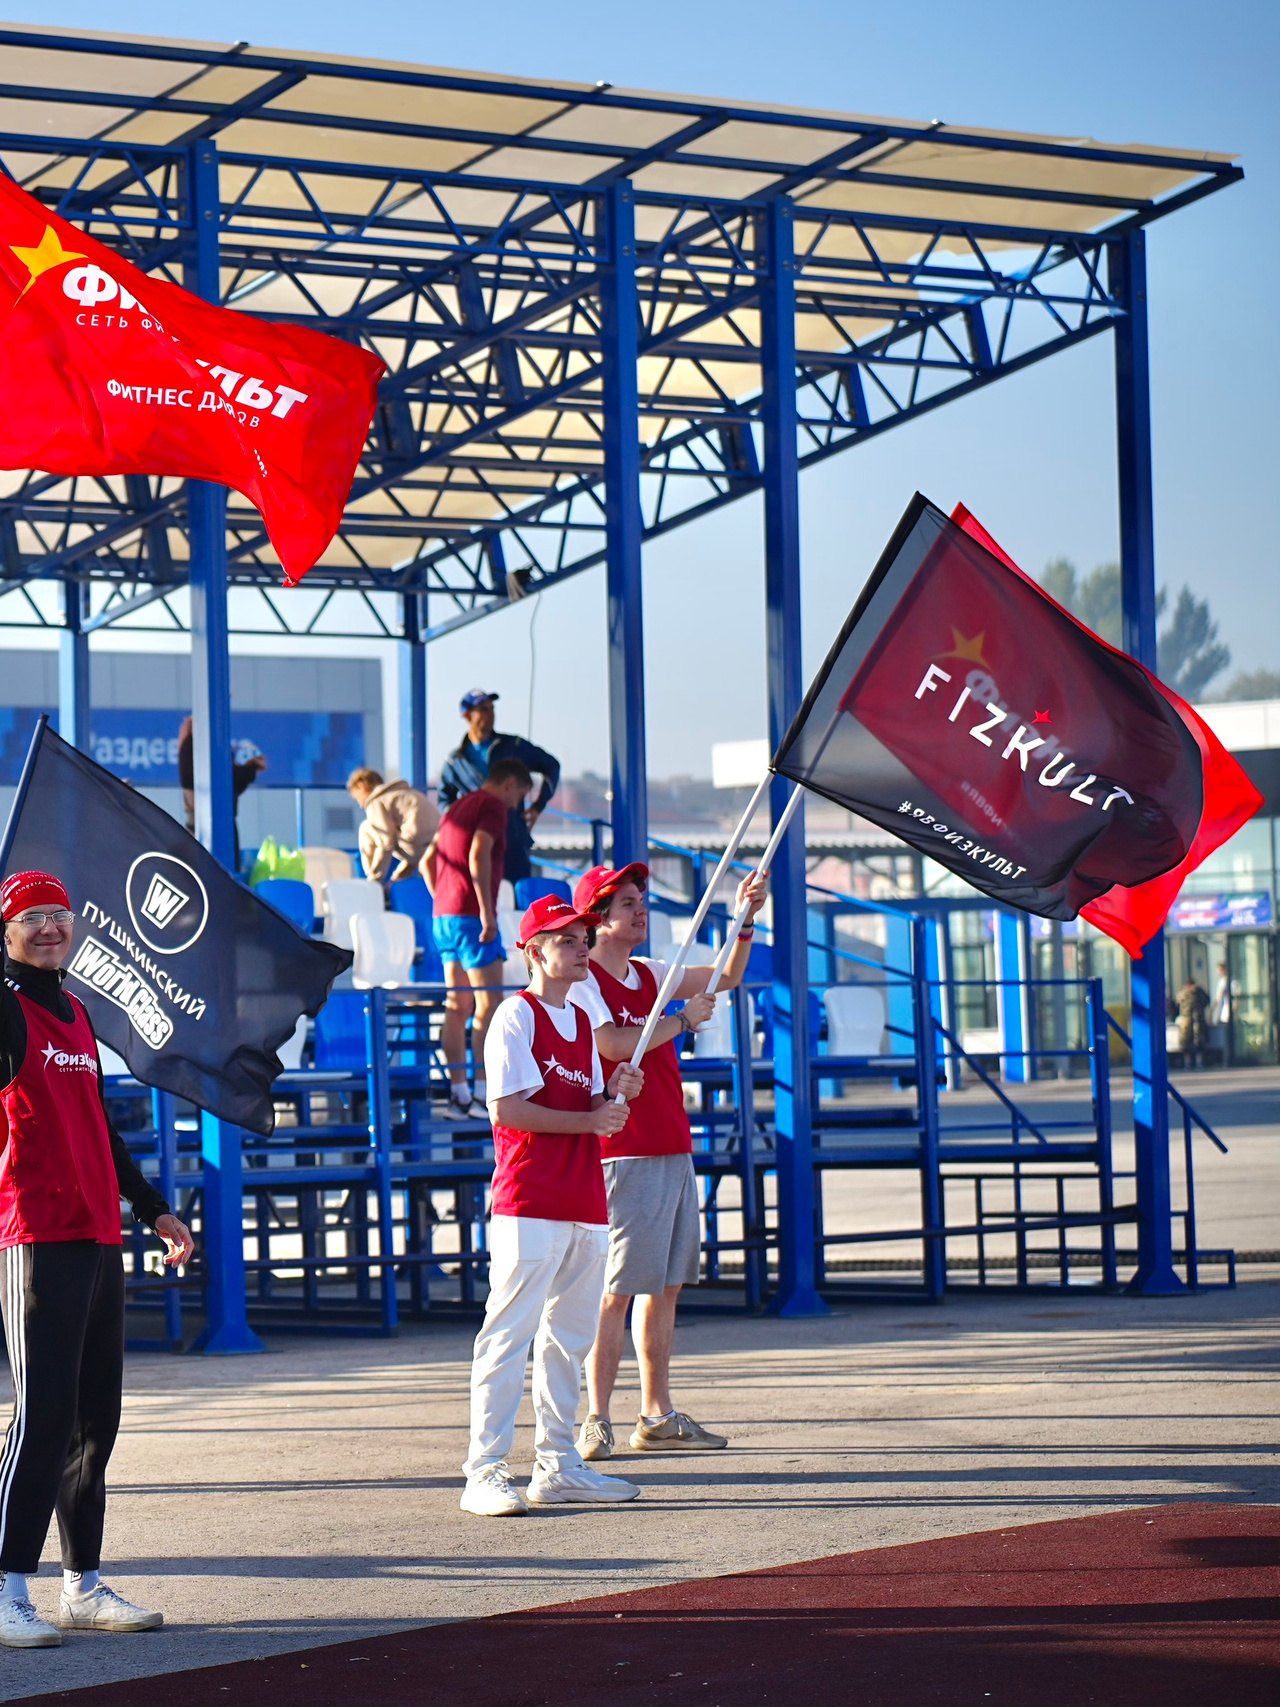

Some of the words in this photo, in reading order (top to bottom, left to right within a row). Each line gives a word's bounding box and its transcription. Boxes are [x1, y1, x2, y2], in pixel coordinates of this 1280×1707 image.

[75, 313, 129, 329] СЕТЬ
[106, 378, 194, 409] ФИТНЕС
[914, 663, 1135, 811] FIZKULT
[897, 800, 1027, 879] #ЯВФИЗКУЛЬТ
[73, 942, 141, 1006] World
[127, 986, 169, 1044] Class
[81, 900, 207, 1021] ПУШКИНСКИЙ
